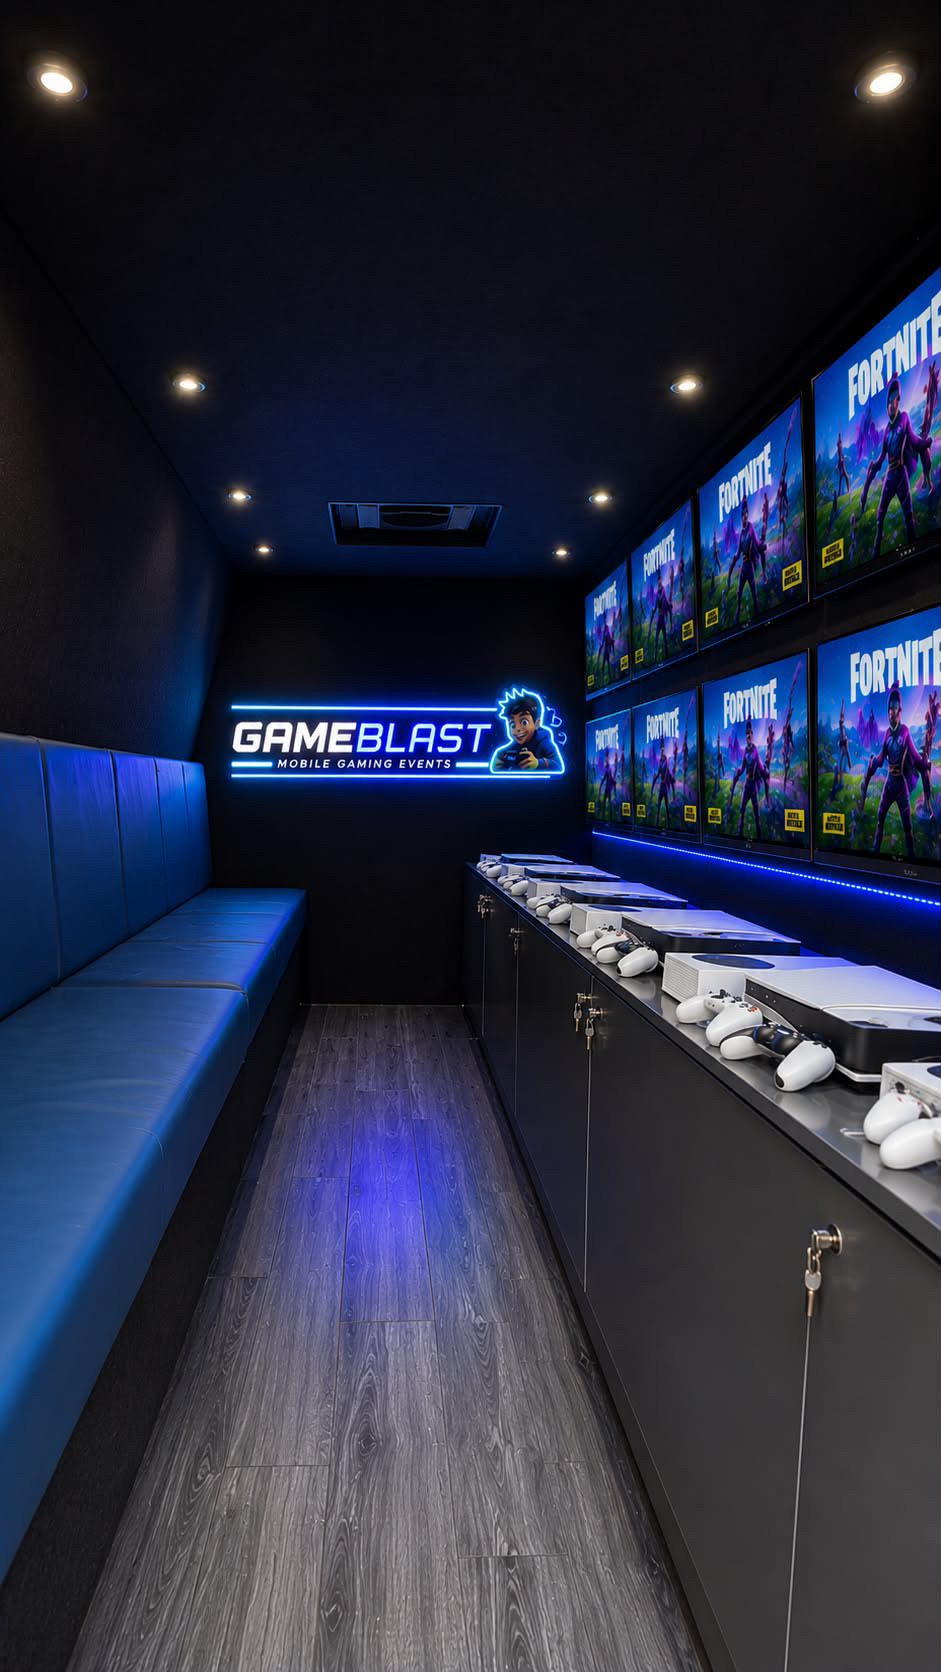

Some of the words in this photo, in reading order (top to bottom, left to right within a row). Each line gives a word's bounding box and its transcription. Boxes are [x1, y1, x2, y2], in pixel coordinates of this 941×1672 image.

[718, 441, 772, 523] FORTNITE
[644, 528, 675, 583] FORTNITE
[646, 707, 680, 744] FORTNITE
[723, 678, 777, 729] FORTNITE
[232, 721, 492, 753] GAMEBLAST
[277, 759, 330, 769] MOBILE
[337, 759, 393, 769] GAMING
[399, 759, 452, 770] EVENTS
